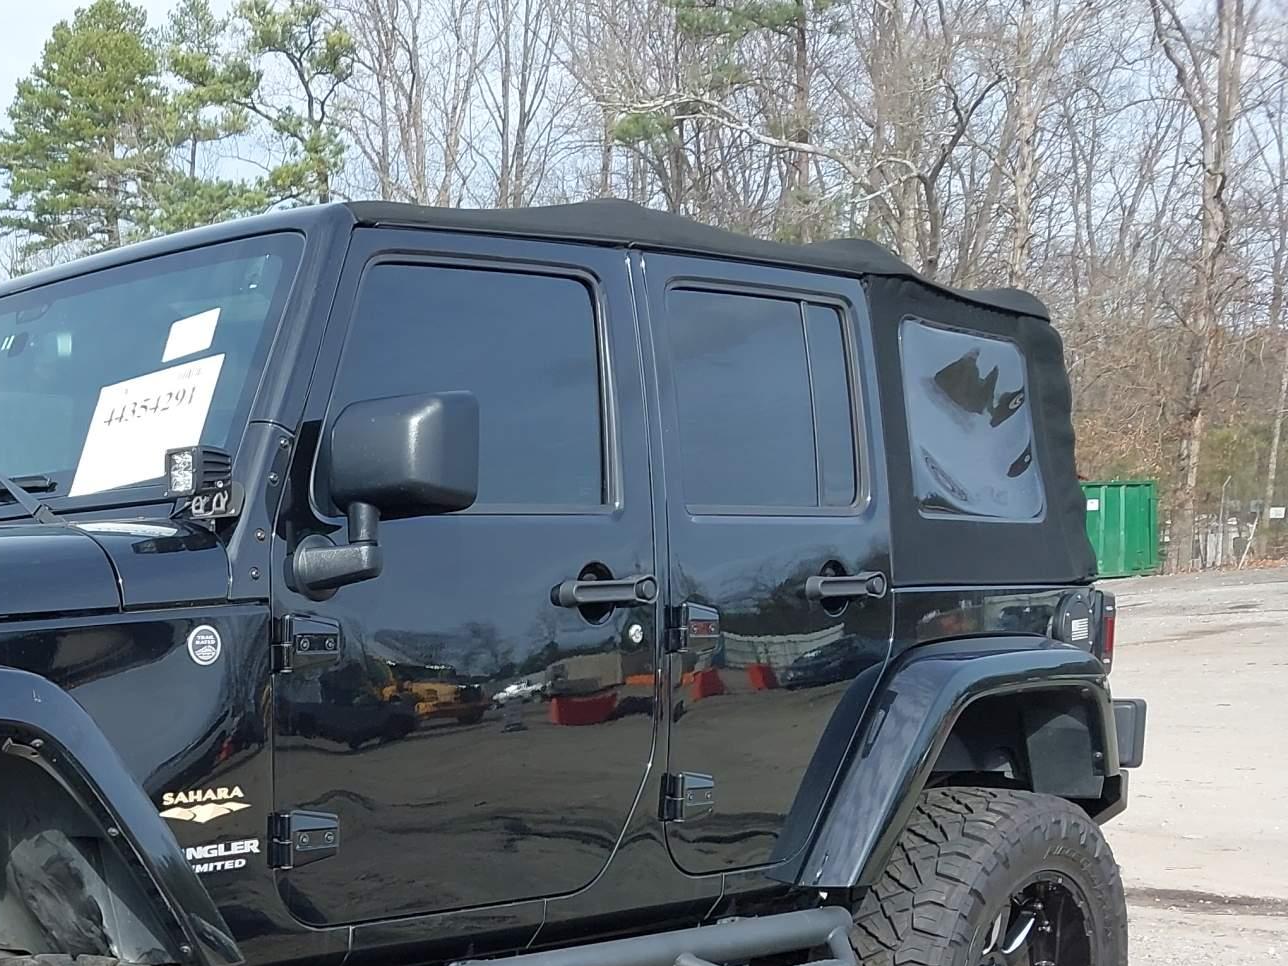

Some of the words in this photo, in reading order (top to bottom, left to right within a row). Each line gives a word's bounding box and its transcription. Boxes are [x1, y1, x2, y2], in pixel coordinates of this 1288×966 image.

[104, 387, 195, 425] 44354291
[162, 785, 245, 806] SAHARA
[181, 838, 261, 861] NGLER
